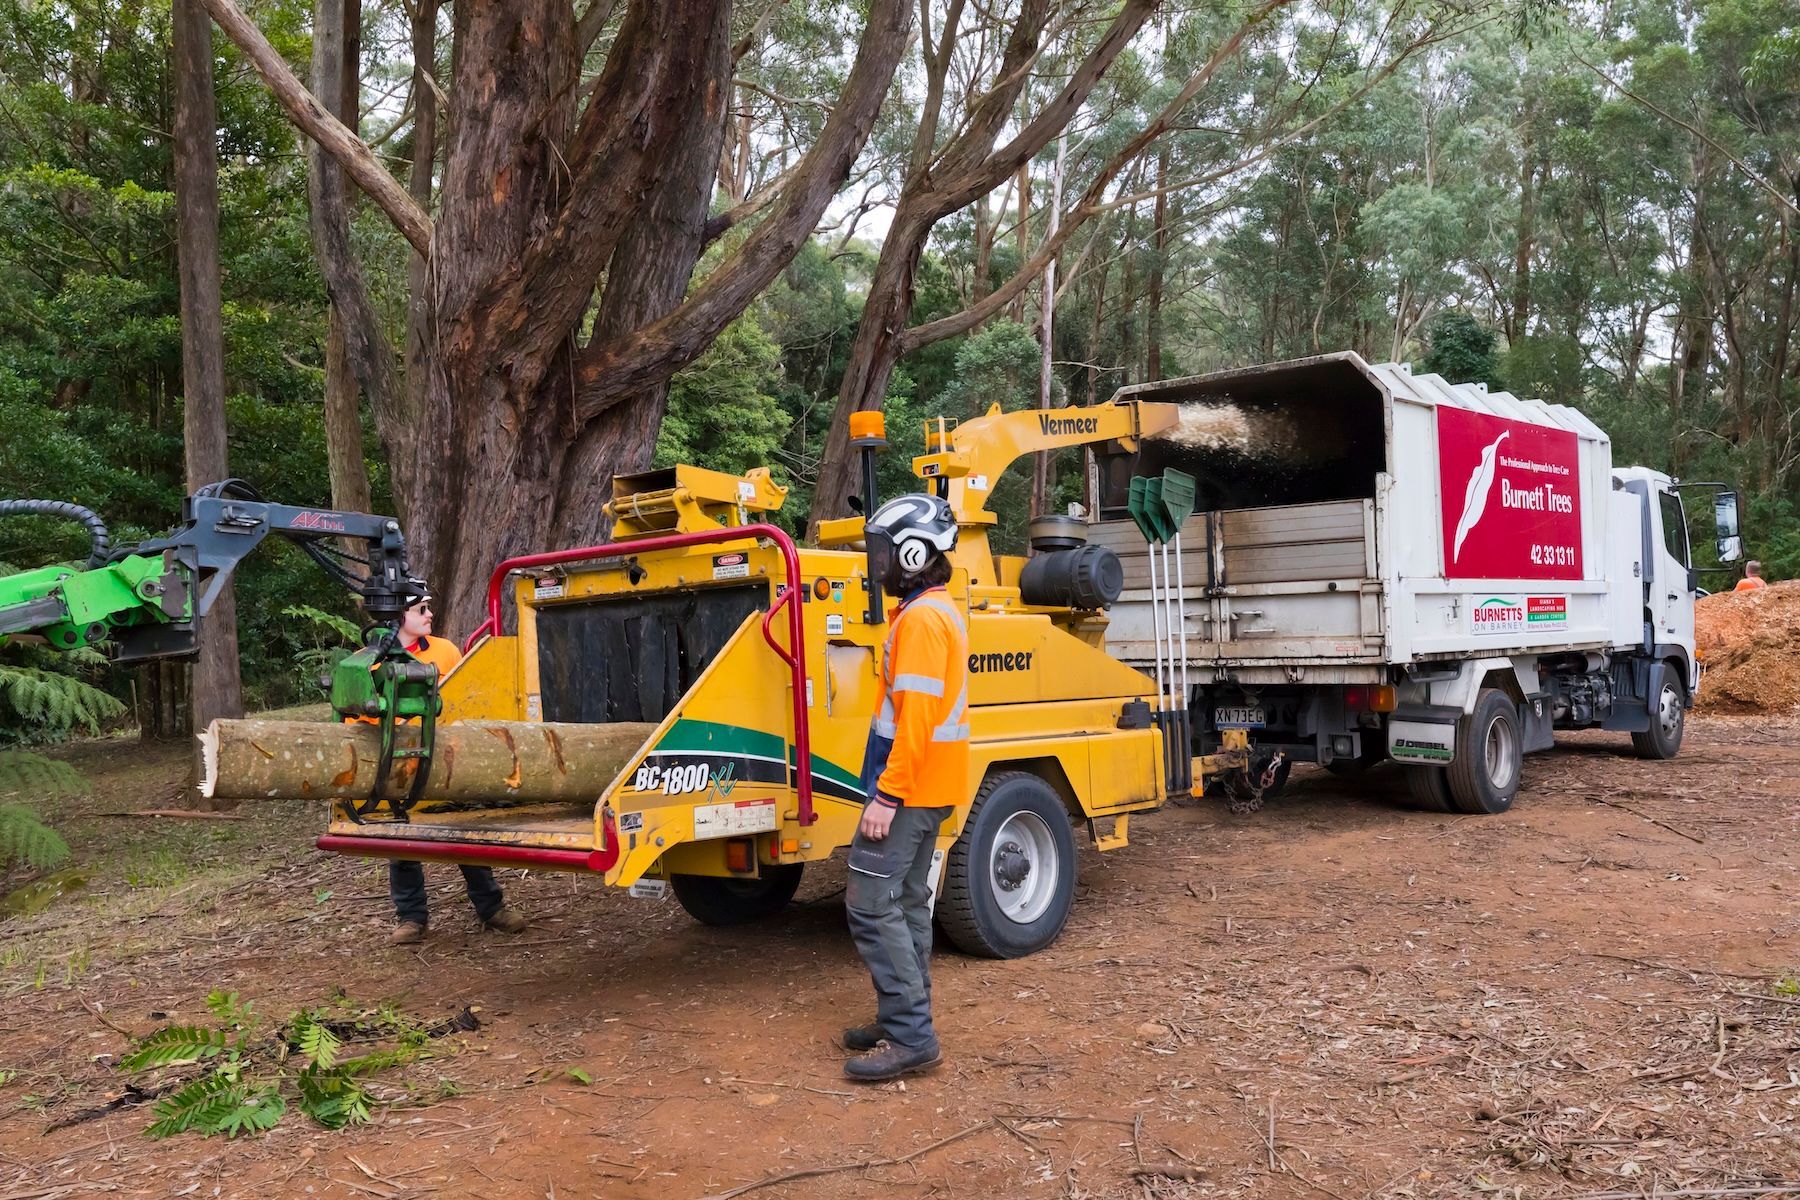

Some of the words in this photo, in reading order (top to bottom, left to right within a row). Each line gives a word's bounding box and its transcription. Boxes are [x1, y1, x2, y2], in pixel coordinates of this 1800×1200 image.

[1038, 414, 1098, 436] Vermeer
[1501, 478, 1544, 511] Burnett
[1545, 483, 1572, 513] Trees
[1474, 607, 1522, 622] BURNETTS
[1474, 623, 1486, 631] ON
[1490, 622, 1522, 631] BARNEY
[967, 651, 1033, 674] ermeer
